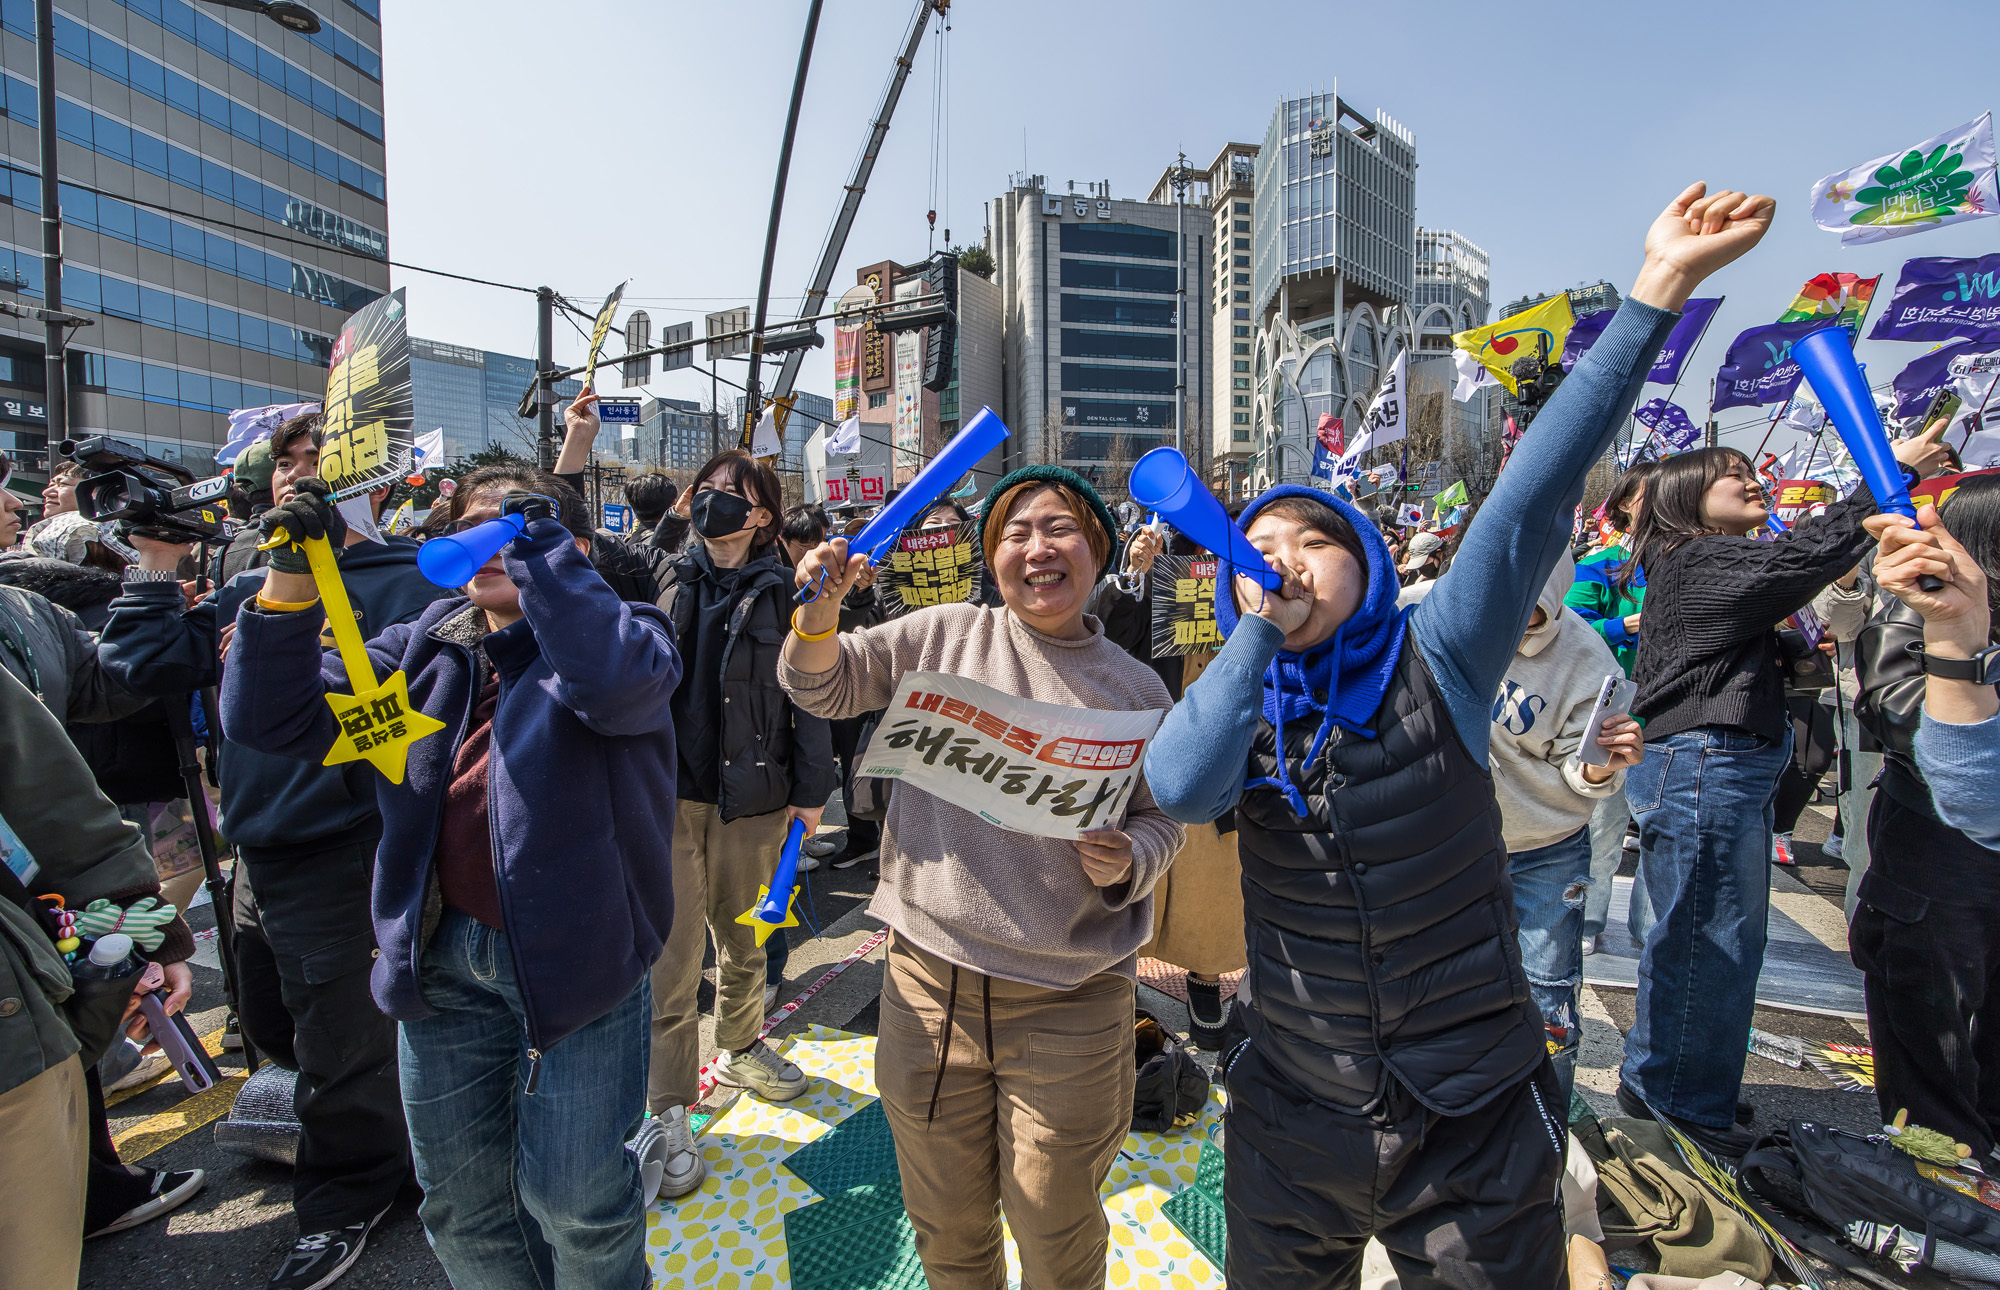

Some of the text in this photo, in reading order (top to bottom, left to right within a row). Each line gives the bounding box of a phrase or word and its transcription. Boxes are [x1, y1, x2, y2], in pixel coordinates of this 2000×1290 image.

[1073, 199, 1111, 219] 동일
[607, 406, 638, 415] 인사동길
[191, 480, 223, 497] KTV
[826, 476, 883, 501] 파면
[892, 542, 972, 573] 윤석열을
[1196, 562, 1217, 576] 내란
[899, 577, 972, 607] 파면하라
[1175, 578, 1217, 602] 윤석
[1173, 619, 1224, 645] 파면
[338, 692, 405, 738] 파면
[353, 720, 407, 753] 윤석열
[904, 691, 1138, 767] 내란동조 국민의힘
[884, 719, 1132, 830] 해체하라!
